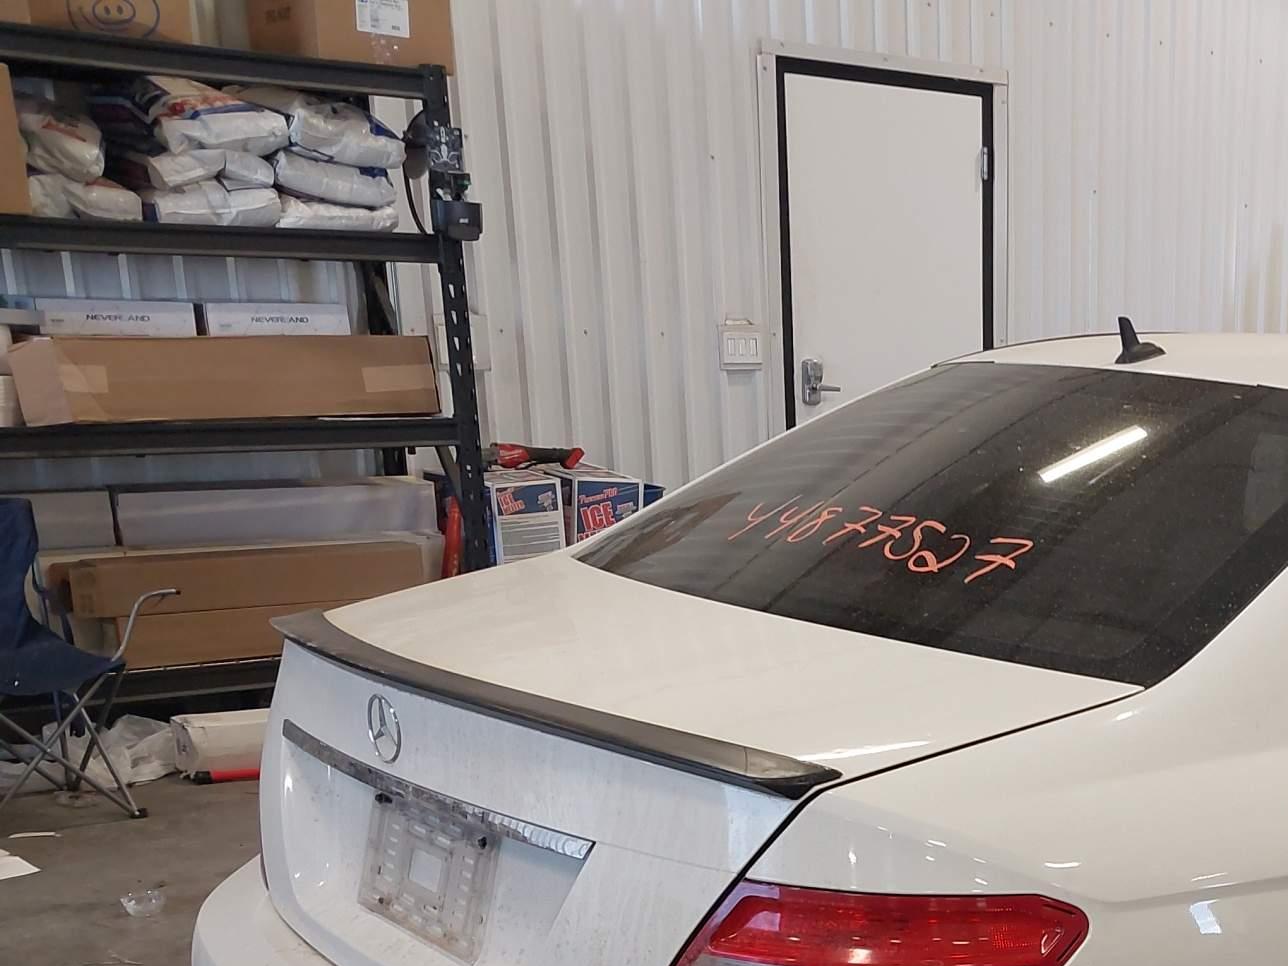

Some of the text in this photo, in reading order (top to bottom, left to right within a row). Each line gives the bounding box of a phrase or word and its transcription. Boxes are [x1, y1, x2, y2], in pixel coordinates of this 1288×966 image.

[86, 313, 151, 322] NEVERAND
[250, 316, 310, 324] NEVERAND
[580, 500, 617, 532] ICE
[727, 495, 1035, 584] 44877527
